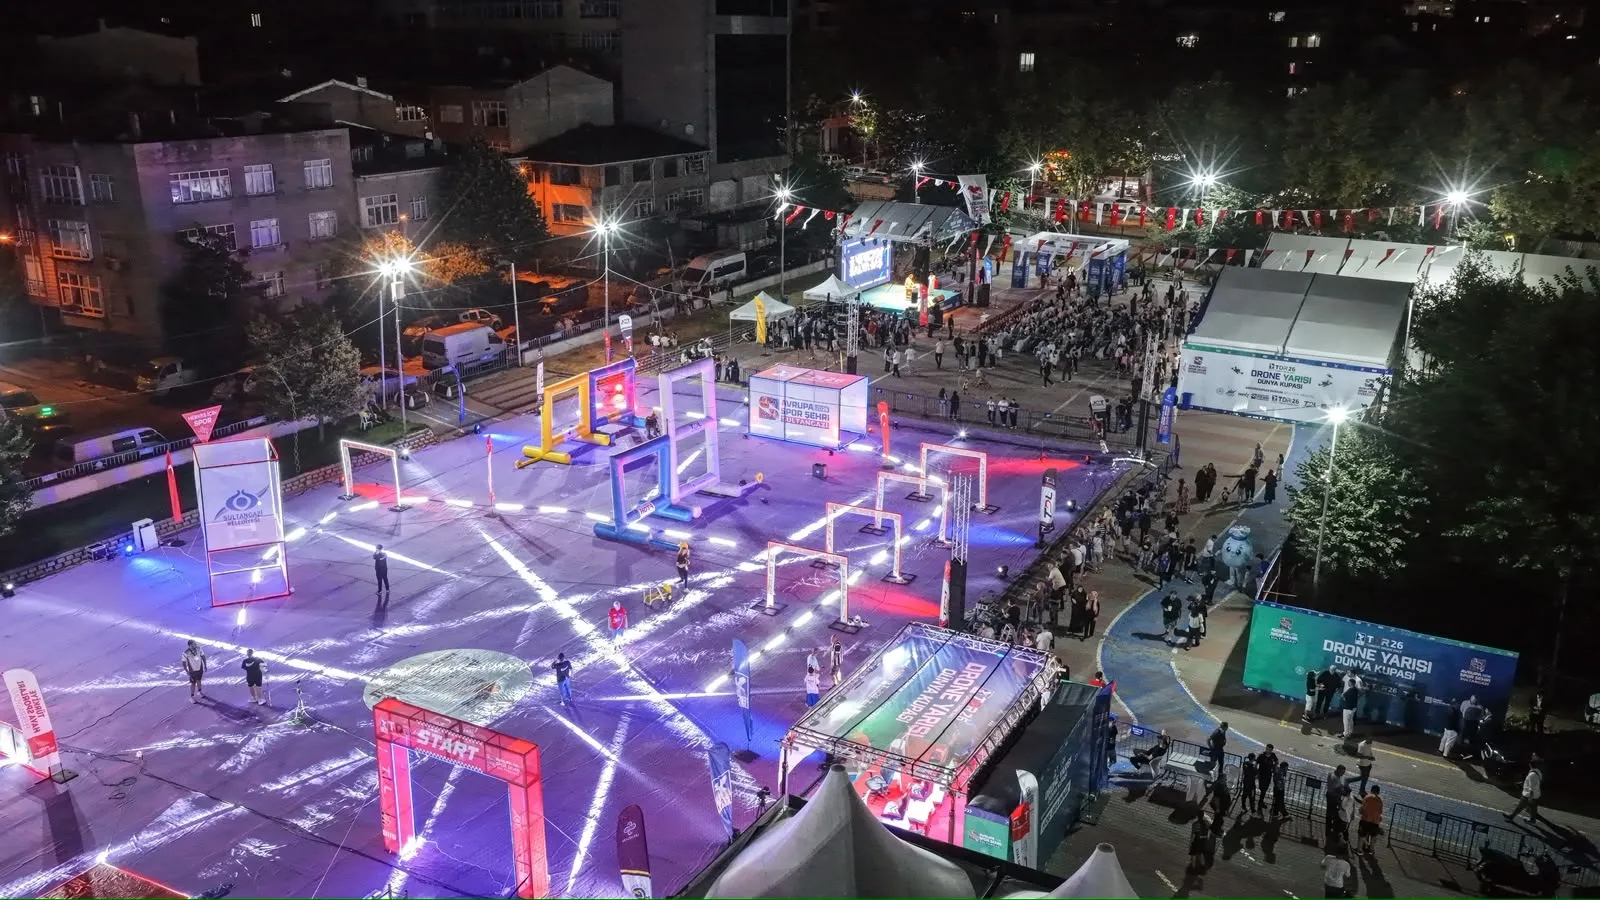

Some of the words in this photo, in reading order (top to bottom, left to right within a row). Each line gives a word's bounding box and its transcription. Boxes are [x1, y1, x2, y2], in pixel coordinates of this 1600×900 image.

[1251, 370, 1282, 380] DRONE
[1280, 382, 1303, 390] KUPASI
[781, 408, 802, 418] SPOR
[782, 399, 814, 412] AVRUPA
[194, 418, 212, 427] SPOR
[1367, 635, 1404, 650] TR26
[1323, 639, 1377, 662] DRONE
[1381, 652, 1432, 674] YARIŞI
[1334, 654, 1372, 672] DÜNYA
[1374, 664, 1416, 680] KUPASI
[940, 662, 987, 704] DRONE
[896, 693, 930, 723] KUPASI
[416, 729, 480, 761] START
